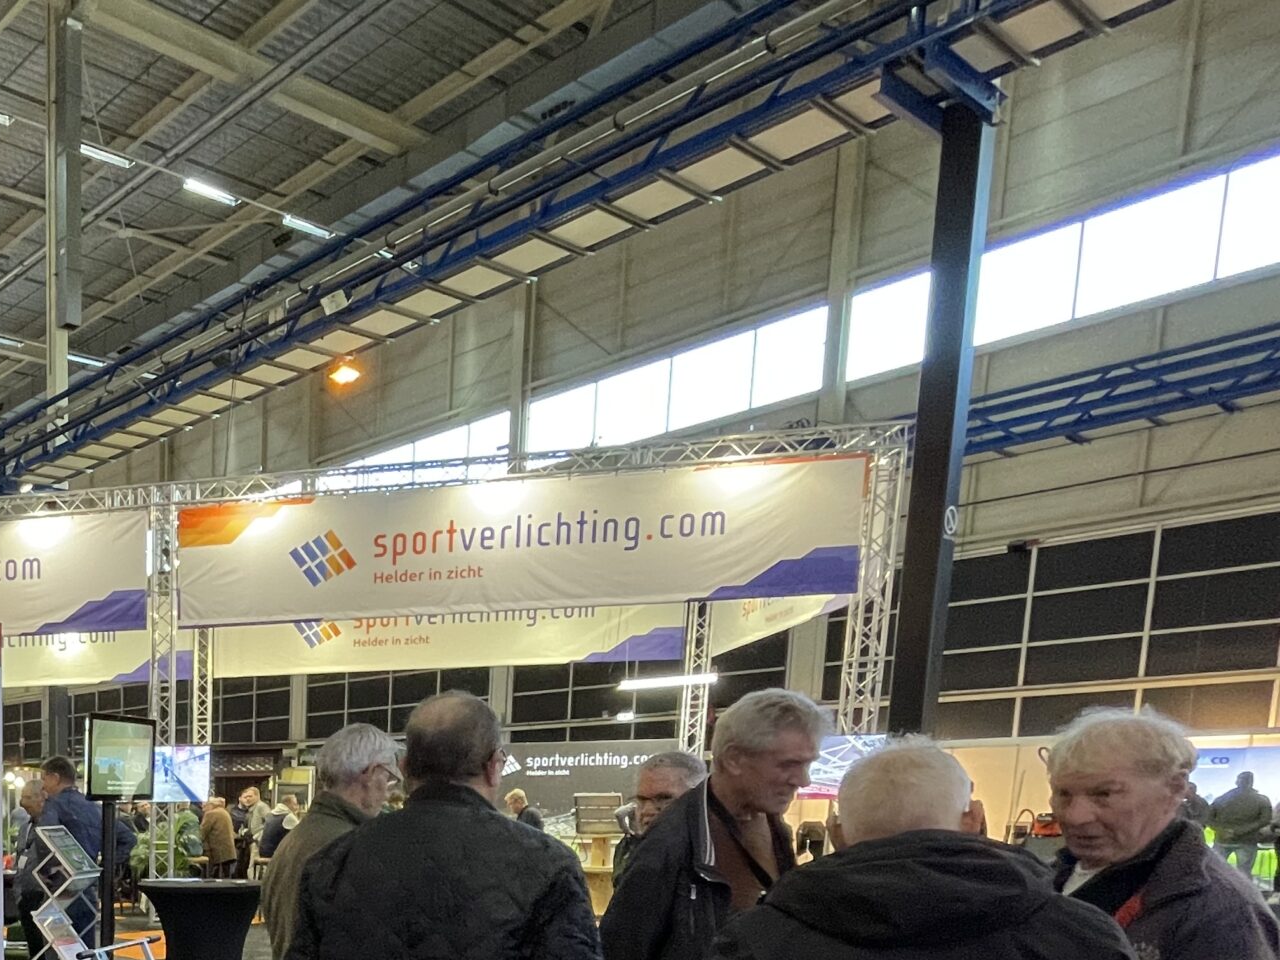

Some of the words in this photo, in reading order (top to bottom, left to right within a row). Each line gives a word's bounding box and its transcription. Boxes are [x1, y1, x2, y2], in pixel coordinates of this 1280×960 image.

[373, 509, 726, 566] sportverlichting.com
[373, 568, 424, 585] Helder
[428, 567, 442, 581] in
[446, 565, 484, 580] zicht
[353, 636, 389, 648] Helder
[391, 635, 402, 646] in
[404, 634, 431, 646] zicht
